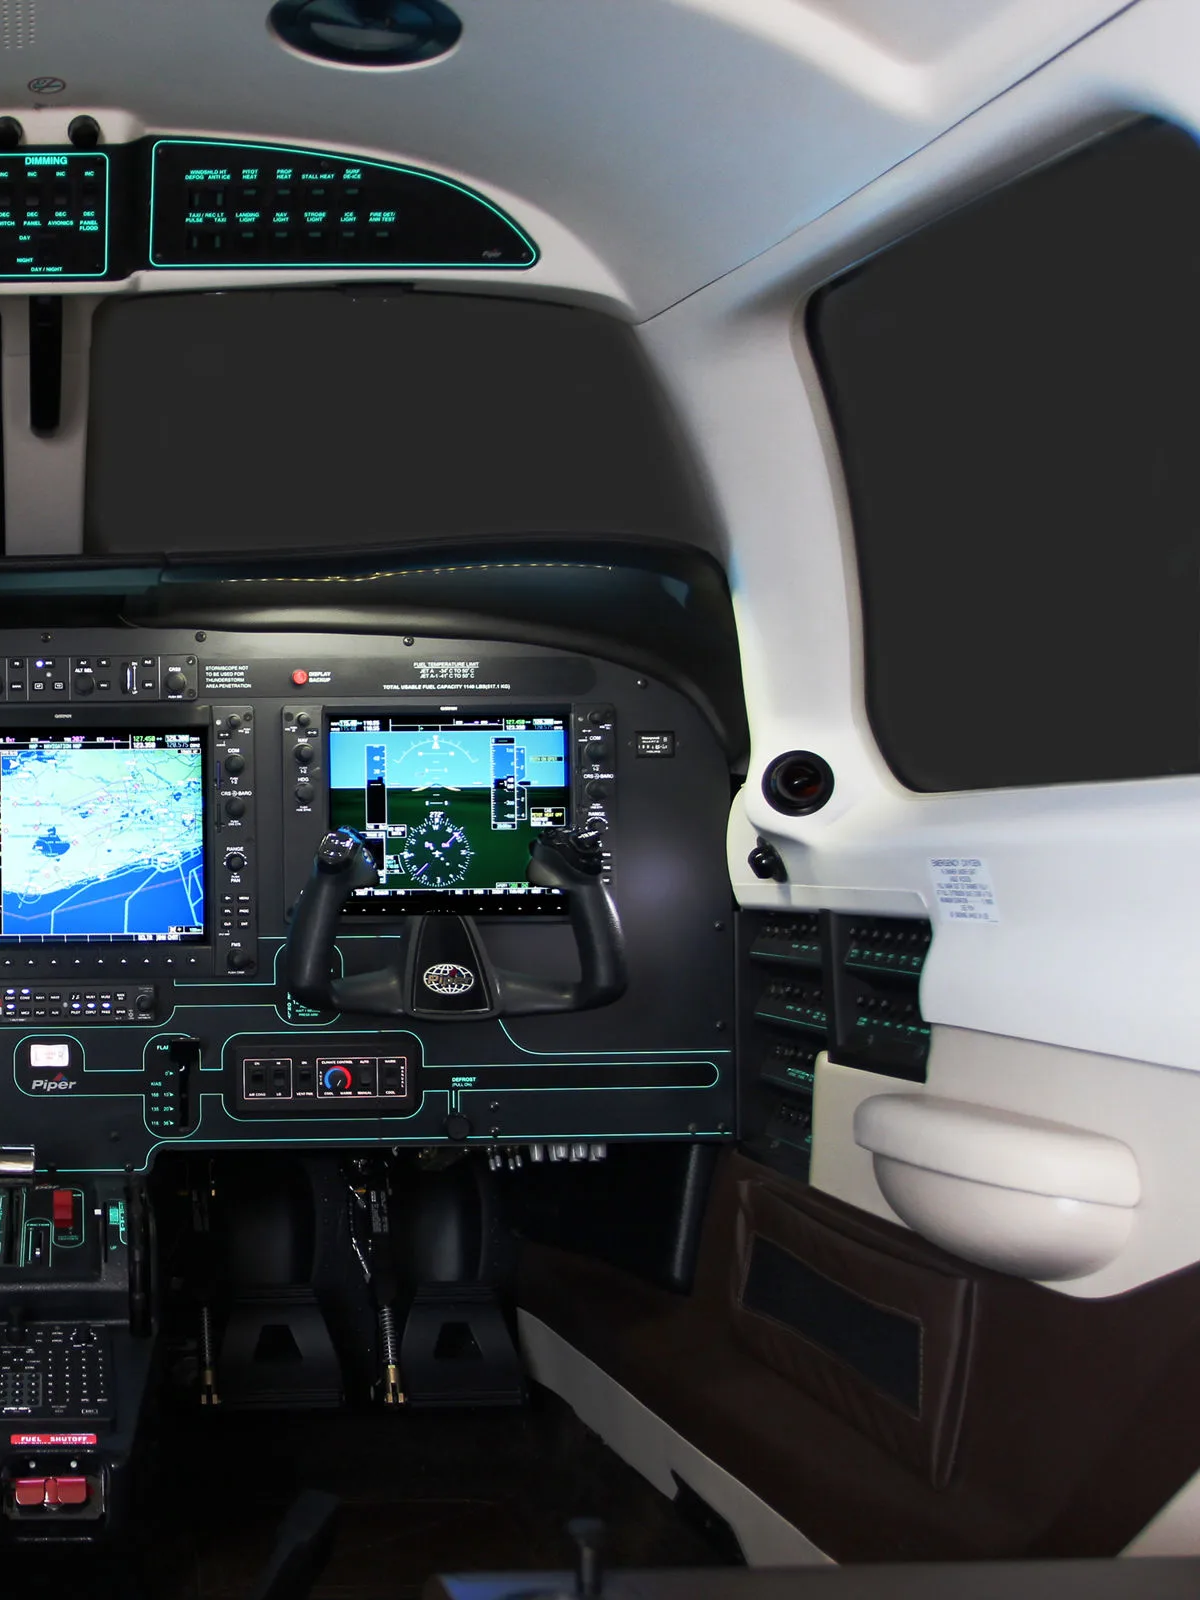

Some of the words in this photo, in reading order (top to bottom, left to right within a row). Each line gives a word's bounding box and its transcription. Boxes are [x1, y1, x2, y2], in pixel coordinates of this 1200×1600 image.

[25, 157, 67, 165] DIMMING
[427, 974, 472, 987] Piper
[32, 1079, 76, 1091] Piper
